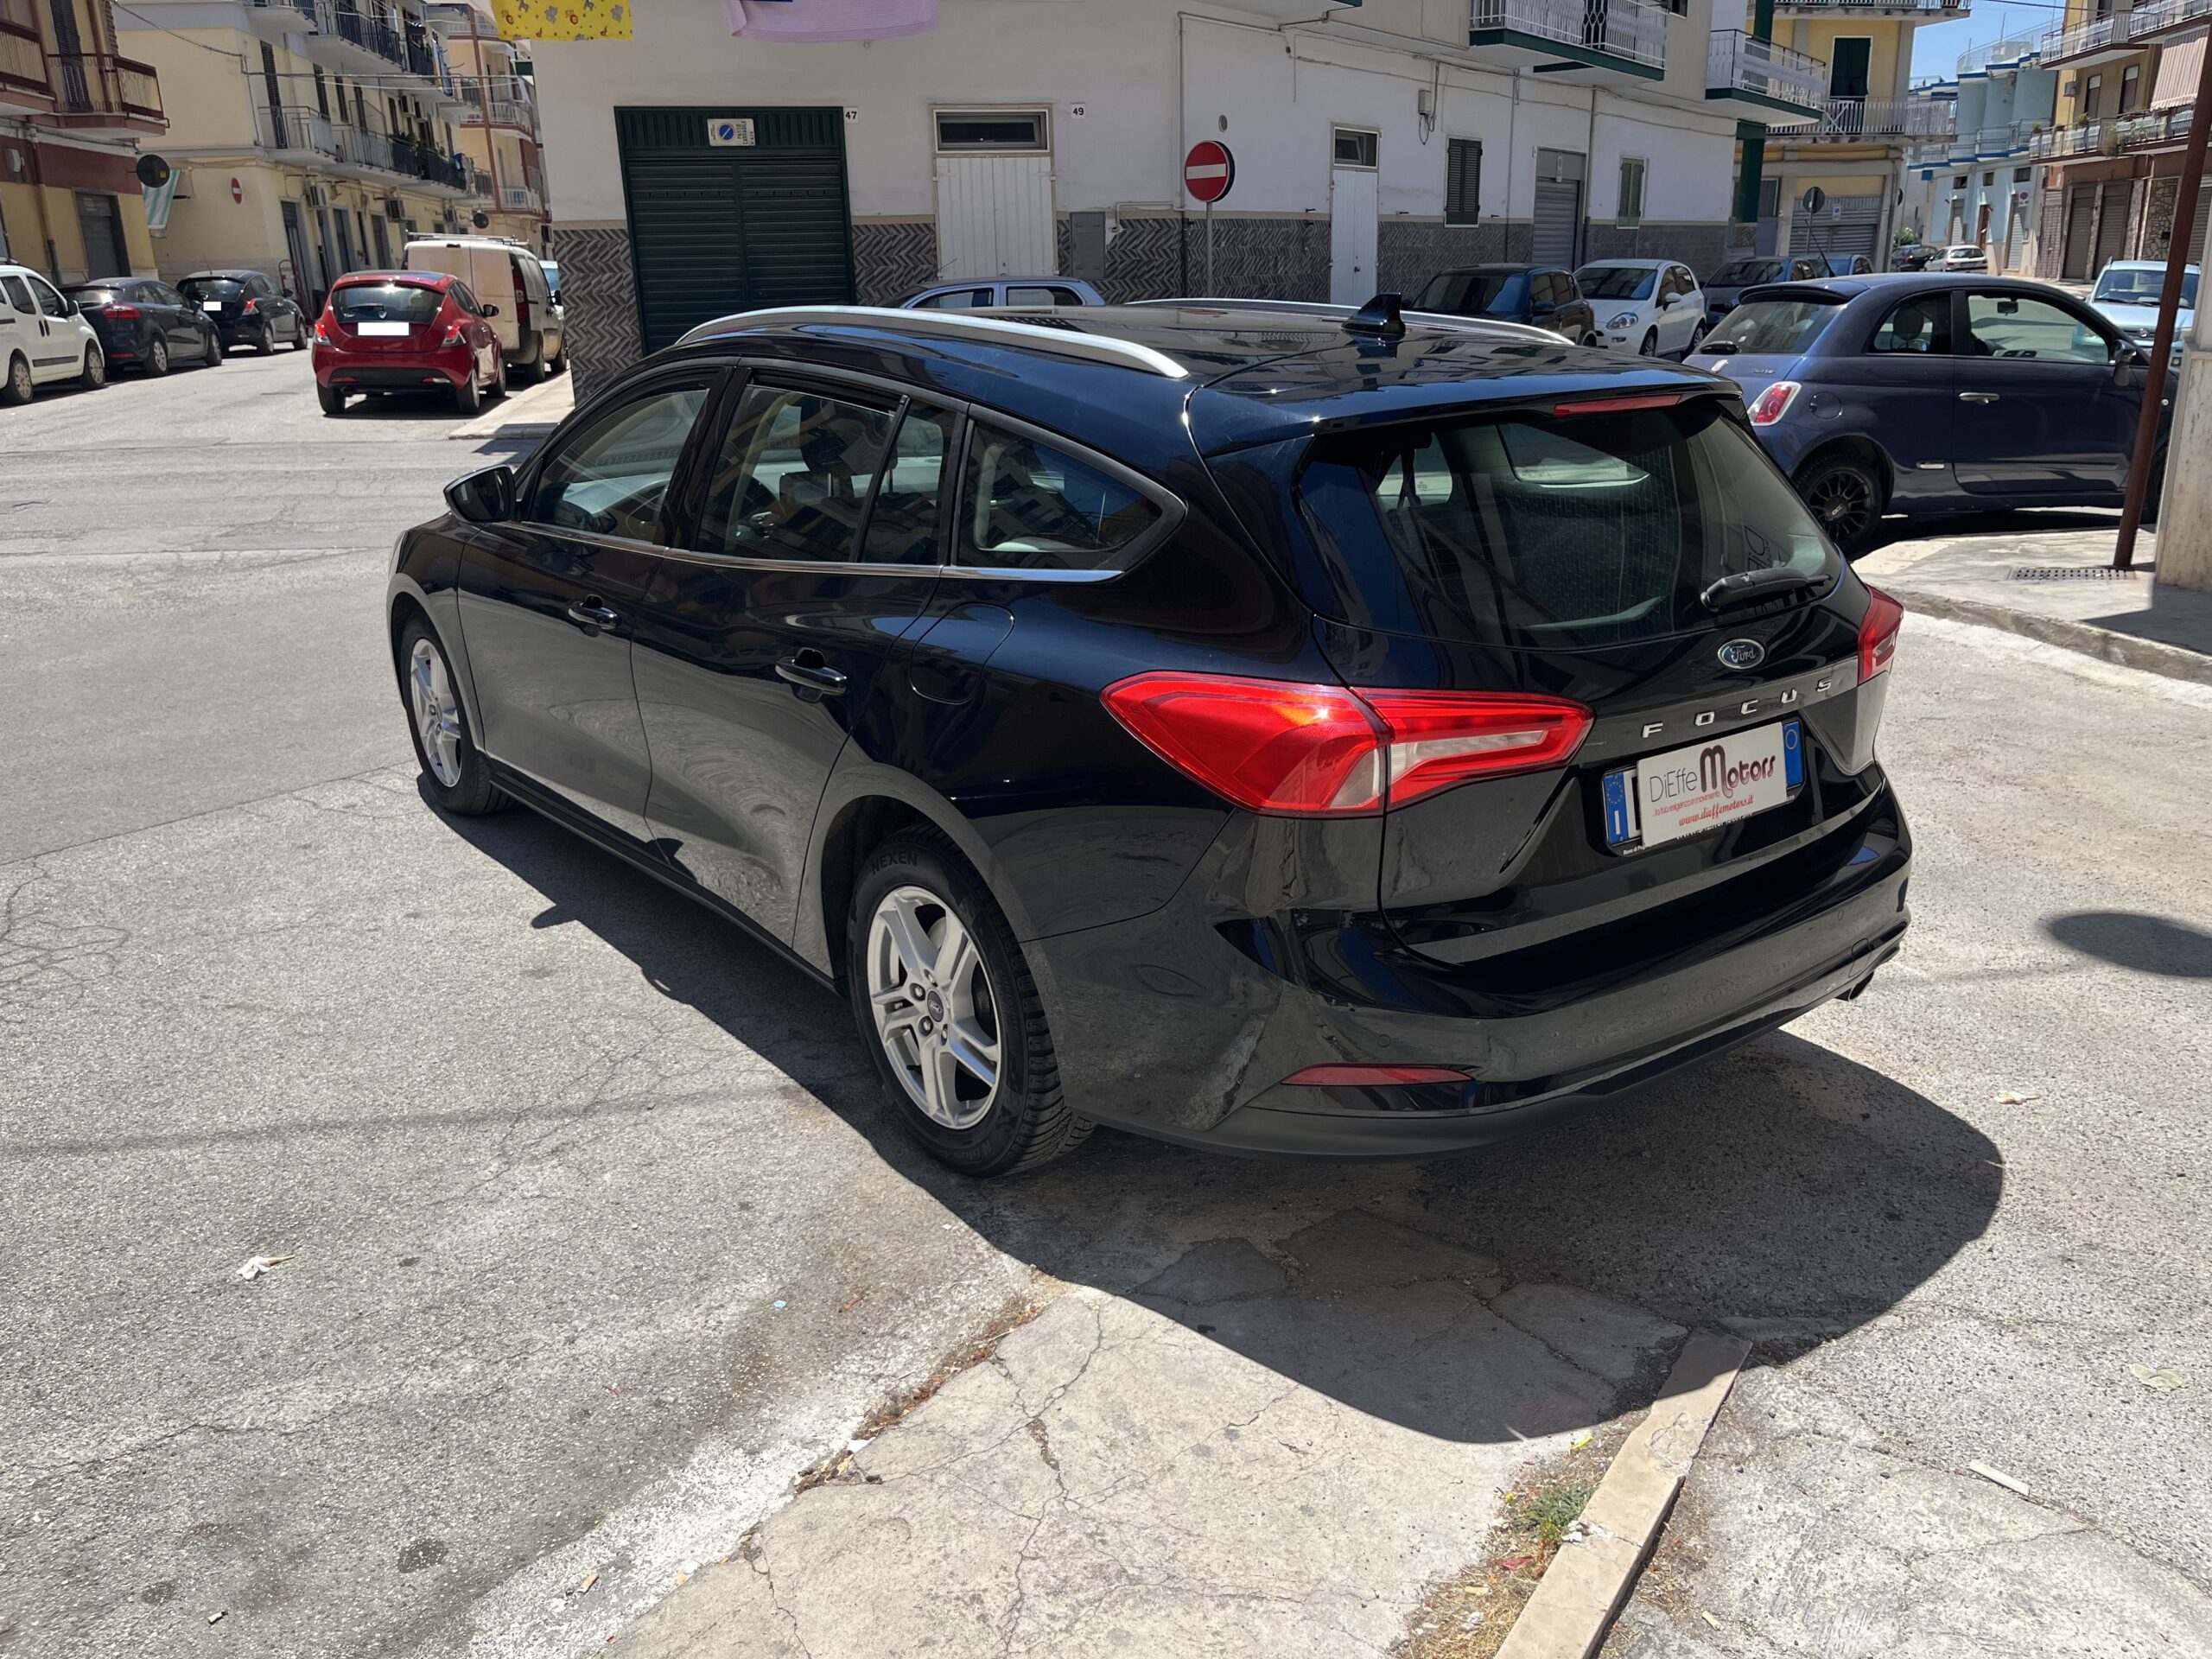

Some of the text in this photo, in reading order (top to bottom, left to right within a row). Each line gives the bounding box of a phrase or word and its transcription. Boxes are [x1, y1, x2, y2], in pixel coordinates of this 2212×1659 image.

[845, 111, 857, 120] 47
[1072, 107, 1084, 116] 49
[1728, 645, 1757, 664] Ford
[1642, 677, 1833, 739] FOCUS
[1649, 767, 1698, 803] DiEffe
[1679, 794, 1754, 827] www.dieffemotors.it
[872, 851, 918, 875] NEXEN
